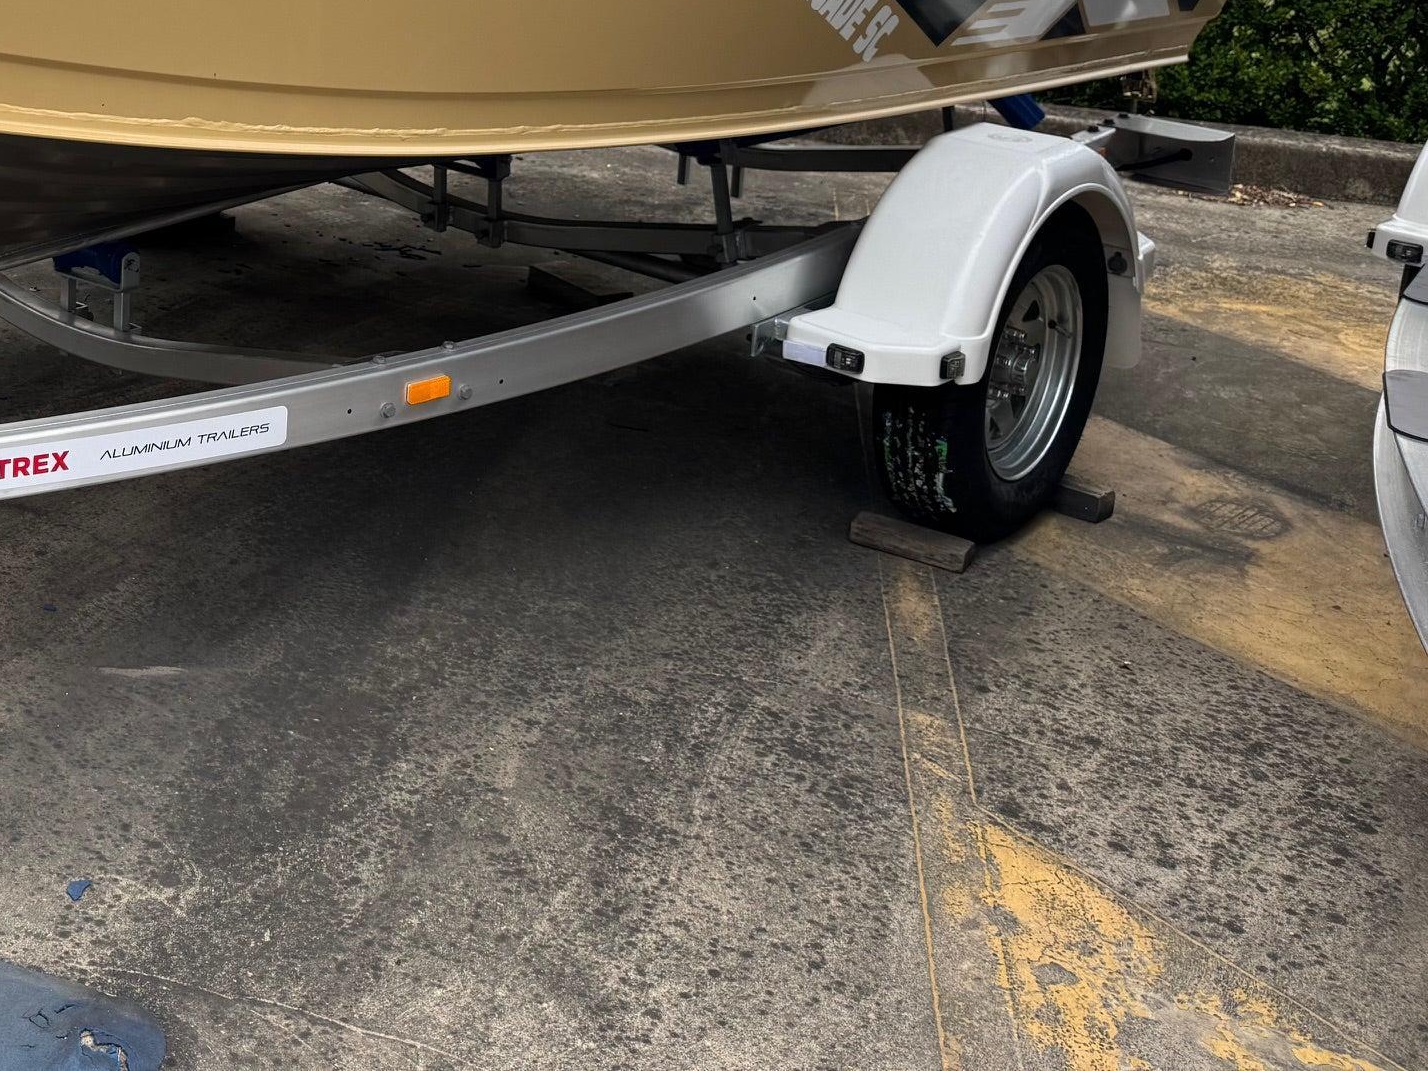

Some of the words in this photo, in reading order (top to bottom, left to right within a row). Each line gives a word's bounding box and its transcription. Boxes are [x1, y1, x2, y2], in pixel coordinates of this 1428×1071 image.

[852, 5, 900, 63] SC
[100, 437, 191, 461] ALUMINIUM
[197, 423, 270, 446] TRAILERS
